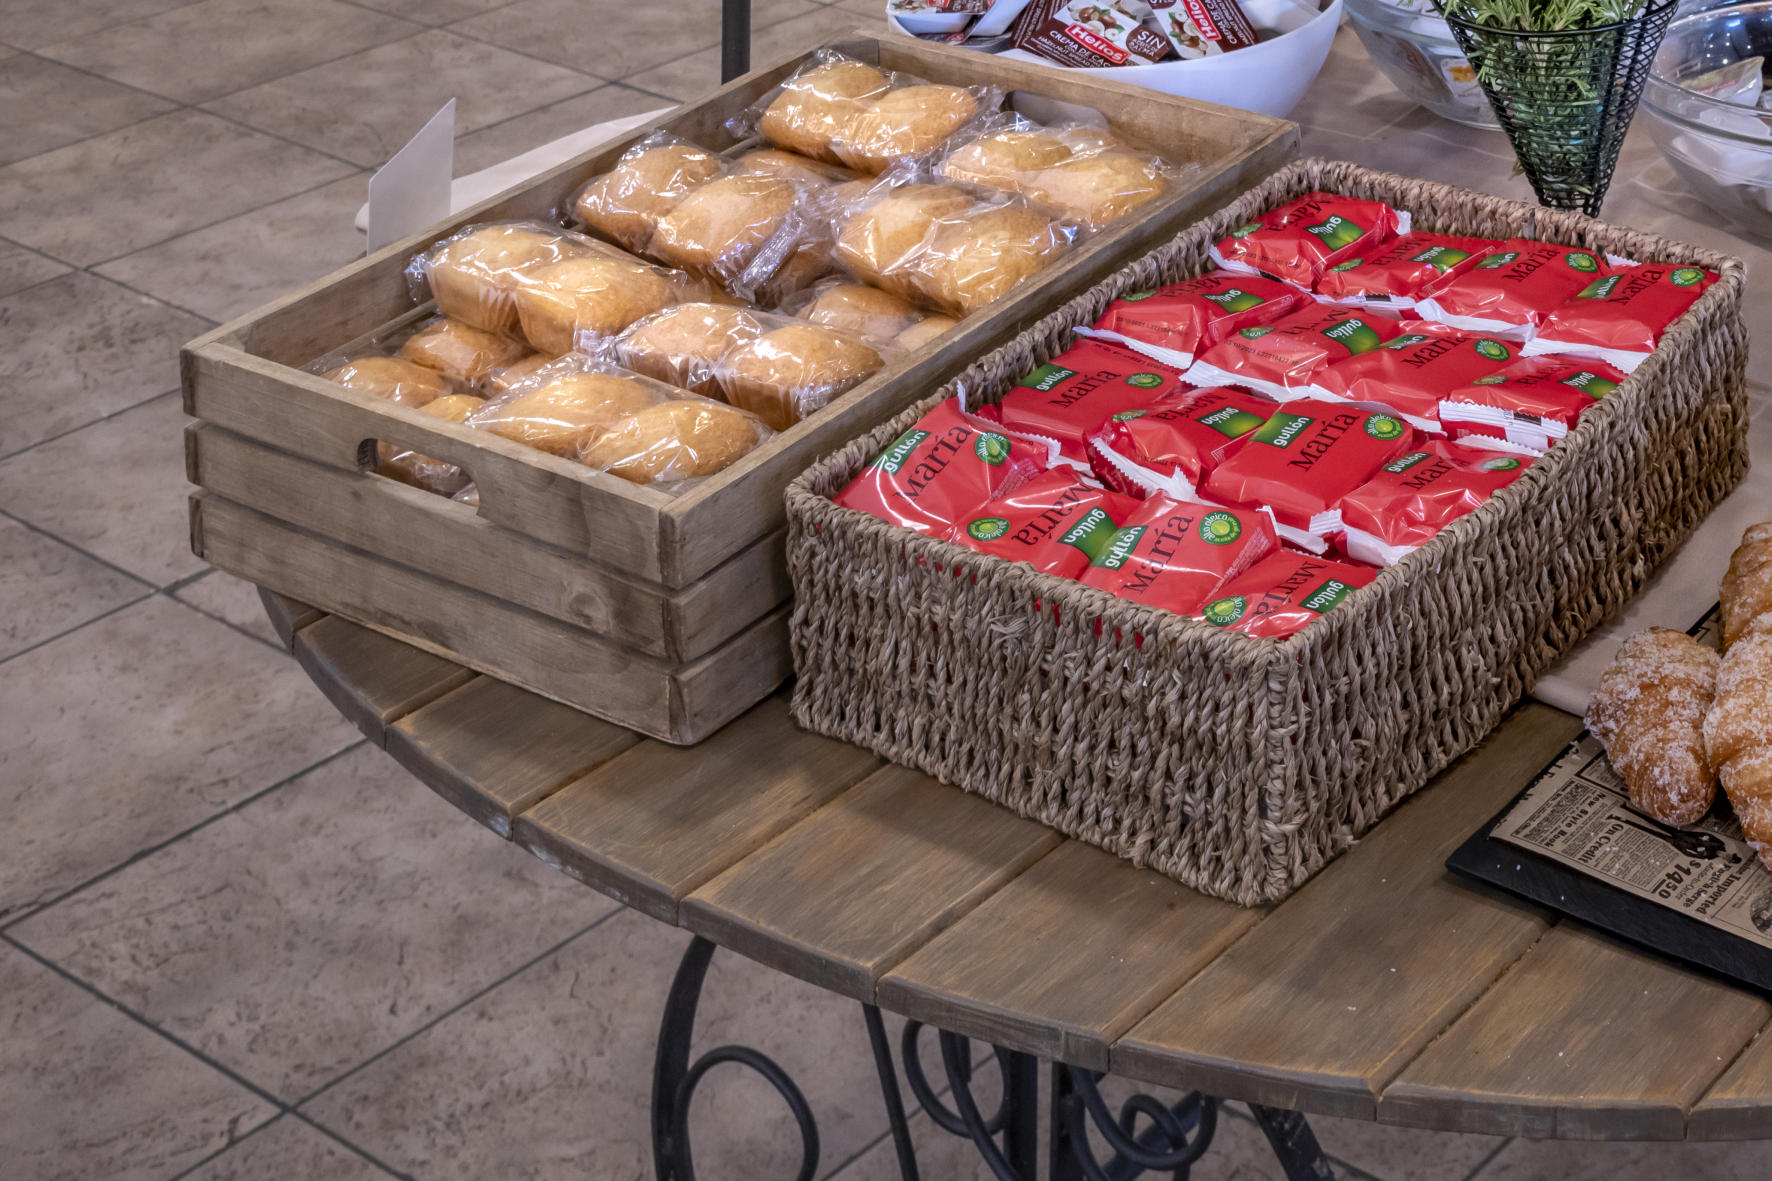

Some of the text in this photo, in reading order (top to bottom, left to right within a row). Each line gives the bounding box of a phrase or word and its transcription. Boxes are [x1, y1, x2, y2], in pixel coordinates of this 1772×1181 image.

[1210, 9, 1222, 21] DE
[1037, 35, 1070, 58] HAZELNUT
[1049, 29, 1112, 68] CREMA DE CAC
[1071, 26, 1124, 61] Helios
[1128, 41, 1156, 58] PALMA
[1137, 30, 1166, 50] SIN
[1217, 22, 1238, 45] CREMA
[1501, 247, 1561, 283] María
[1607, 269, 1667, 306] María
[1326, 318, 1363, 339] gullón
[1400, 335, 1471, 369] María
[1036, 368, 1074, 392] gullón
[1048, 369, 1122, 409] María
[1200, 406, 1240, 426] gullón
[1273, 416, 1310, 447] gullón
[883, 430, 927, 473] gullón
[1287, 413, 1361, 473] María
[893, 425, 974, 506] María
[1387, 451, 1427, 474] gullón
[1010, 482, 1096, 546] María
[1063, 508, 1107, 544] gullón
[1203, 513, 1228, 527] oleico
[1104, 525, 1142, 568] gullón
[1202, 525, 1216, 540] alto
[1213, 534, 1229, 543] aceite
[1120, 514, 1195, 596] María
[1251, 560, 1328, 618] María
[1305, 580, 1345, 610] gullón
[1216, 607, 1242, 624] oleico
[1544, 792, 1607, 848] New Style Book
[1577, 822, 1625, 864] On Credit
[1705, 862, 1733, 892] English
[1682, 887, 1709, 909] Serge
[1694, 873, 1742, 916] Imported
